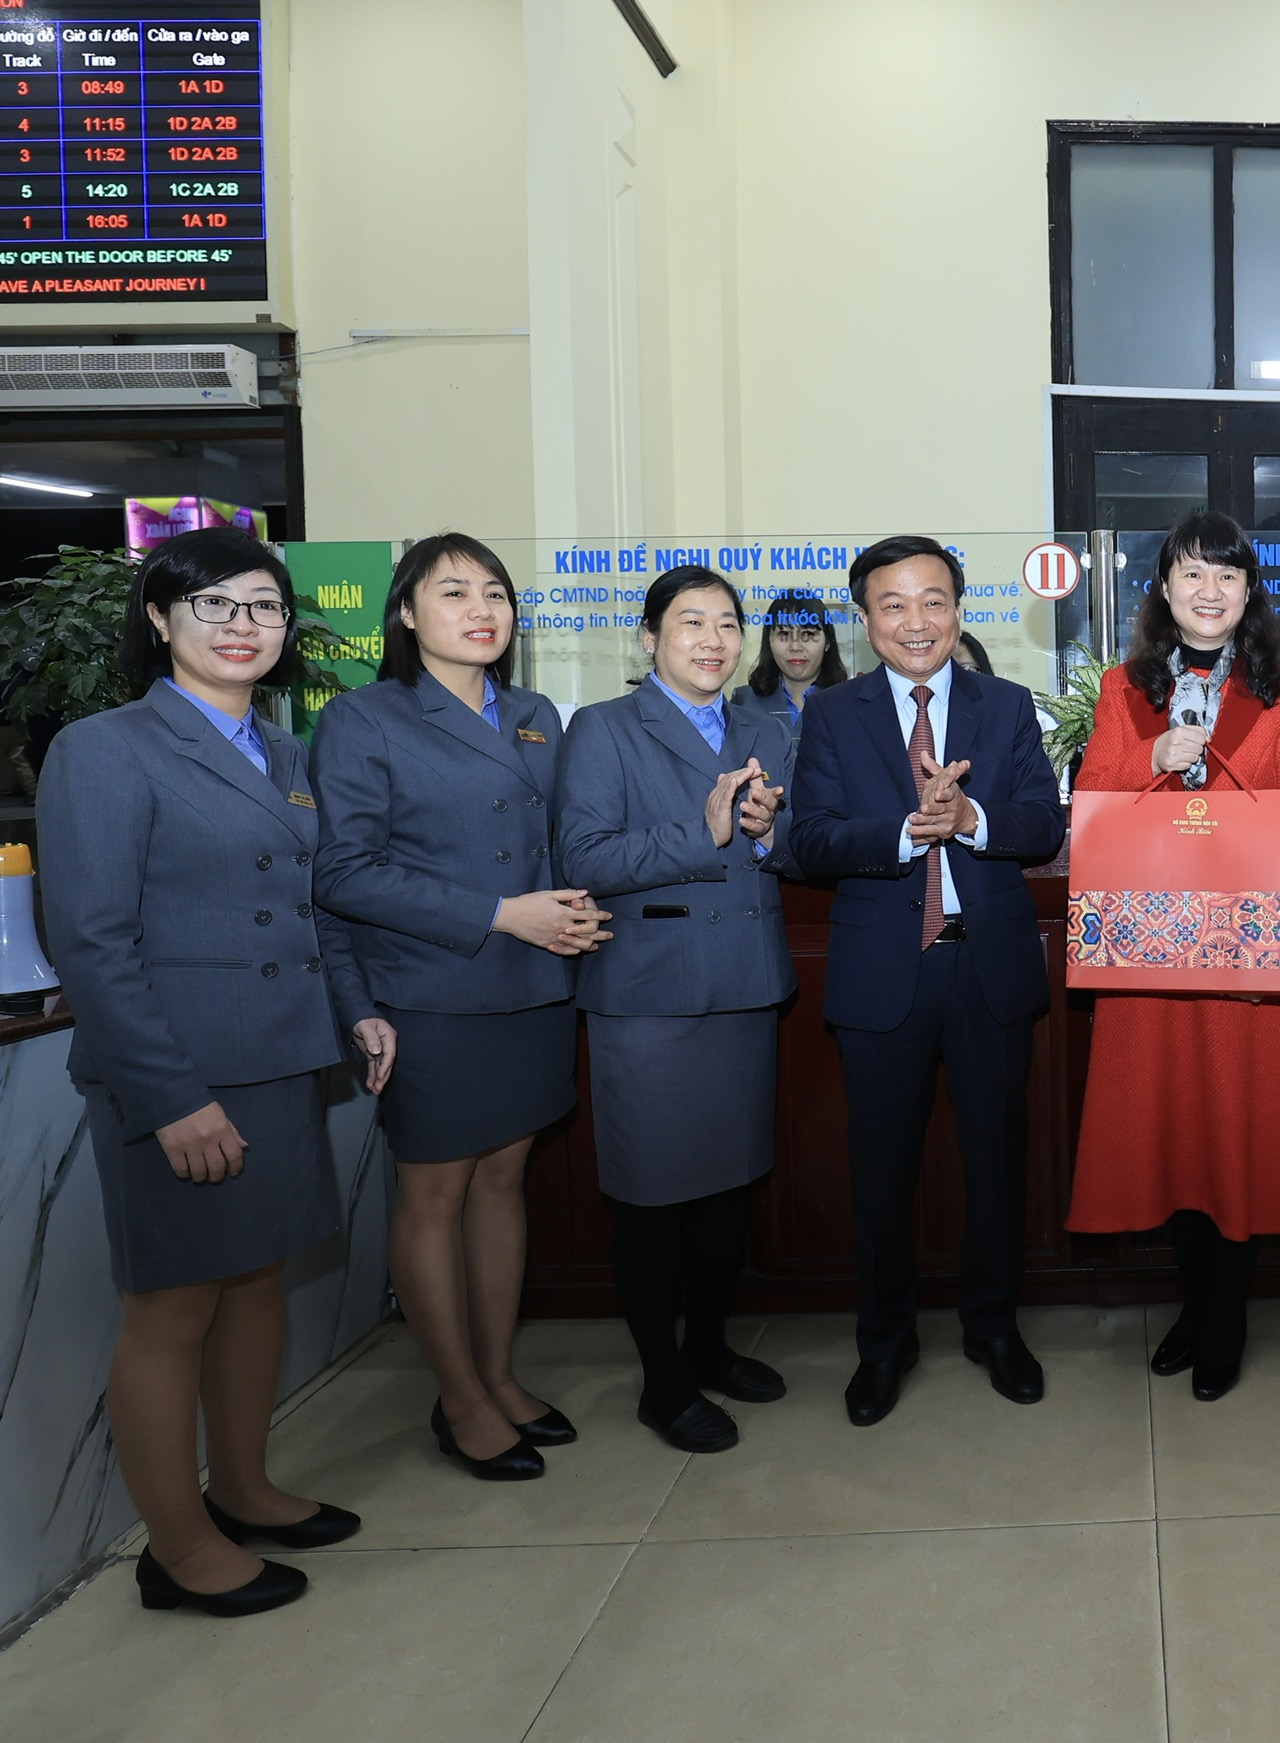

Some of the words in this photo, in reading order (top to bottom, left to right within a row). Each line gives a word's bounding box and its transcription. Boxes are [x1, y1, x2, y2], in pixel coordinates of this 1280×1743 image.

[62, 29, 86, 42] Giờ
[89, 29, 102, 42] đi
[112, 27, 138, 42] đến
[148, 28, 176, 42] Cửa
[179, 32, 192, 42] ra
[203, 29, 229, 42] vào
[231, 32, 249, 45] ga
[3, 54, 42, 67] Track
[82, 53, 116, 66] Time
[193, 54, 226, 66] Gate
[18, 82, 29, 95] 3
[82, 82, 125, 94] 08:49
[179, 81, 199, 93] 1A
[203, 81, 224, 93] 1D
[18, 119, 30, 132] 4
[83, 118, 126, 131] 11:15
[168, 118, 188, 130] 1D
[191, 118, 213, 130] 2A
[216, 117, 237, 130] 2B
[20, 150, 31, 162] 3
[84, 149, 126, 161] 11:52
[168, 148, 188, 160] 1D
[191, 148, 214, 160] 2A
[216, 147, 238, 160] 2B
[21, 185, 32, 198] 5
[86, 184, 128, 197] 14:20
[169, 184, 190, 196] 1C
[193, 183, 215, 195] 2A
[217, 183, 239, 195] 2B
[23, 216, 31, 229] 1
[86, 215, 128, 228] 16:05
[182, 215, 202, 227] 1A
[206, 214, 227, 226] 1D
[20, 252, 63, 264] OPEN
[65, 251, 96, 263] THE
[99, 251, 144, 263] DOOR
[146, 250, 208, 262] BEFORE
[31, 279, 44, 292] A
[45, 279, 123, 292] PLEASANT
[125, 278, 198, 291] JOURNEY
[555, 545, 611, 573] KÍNH
[618, 542, 647, 572] ĐỀ
[719, 543, 762, 572] QUÝ
[771, 542, 847, 570] KHÁCH
[1038, 553, 1068, 590] 11
[317, 580, 363, 614] NHẬN
[550, 588, 609, 604] CMTND
[614, 586, 647, 606] hoặ
[752, 585, 790, 599] thân
[793, 582, 824, 600] của
[999, 581, 1023, 597] vé.
[537, 613, 584, 632] thông
[589, 613, 608, 628] tin
[777, 608, 819, 625] trước
[825, 609, 849, 625] khi
[1000, 607, 1020, 623] vé
